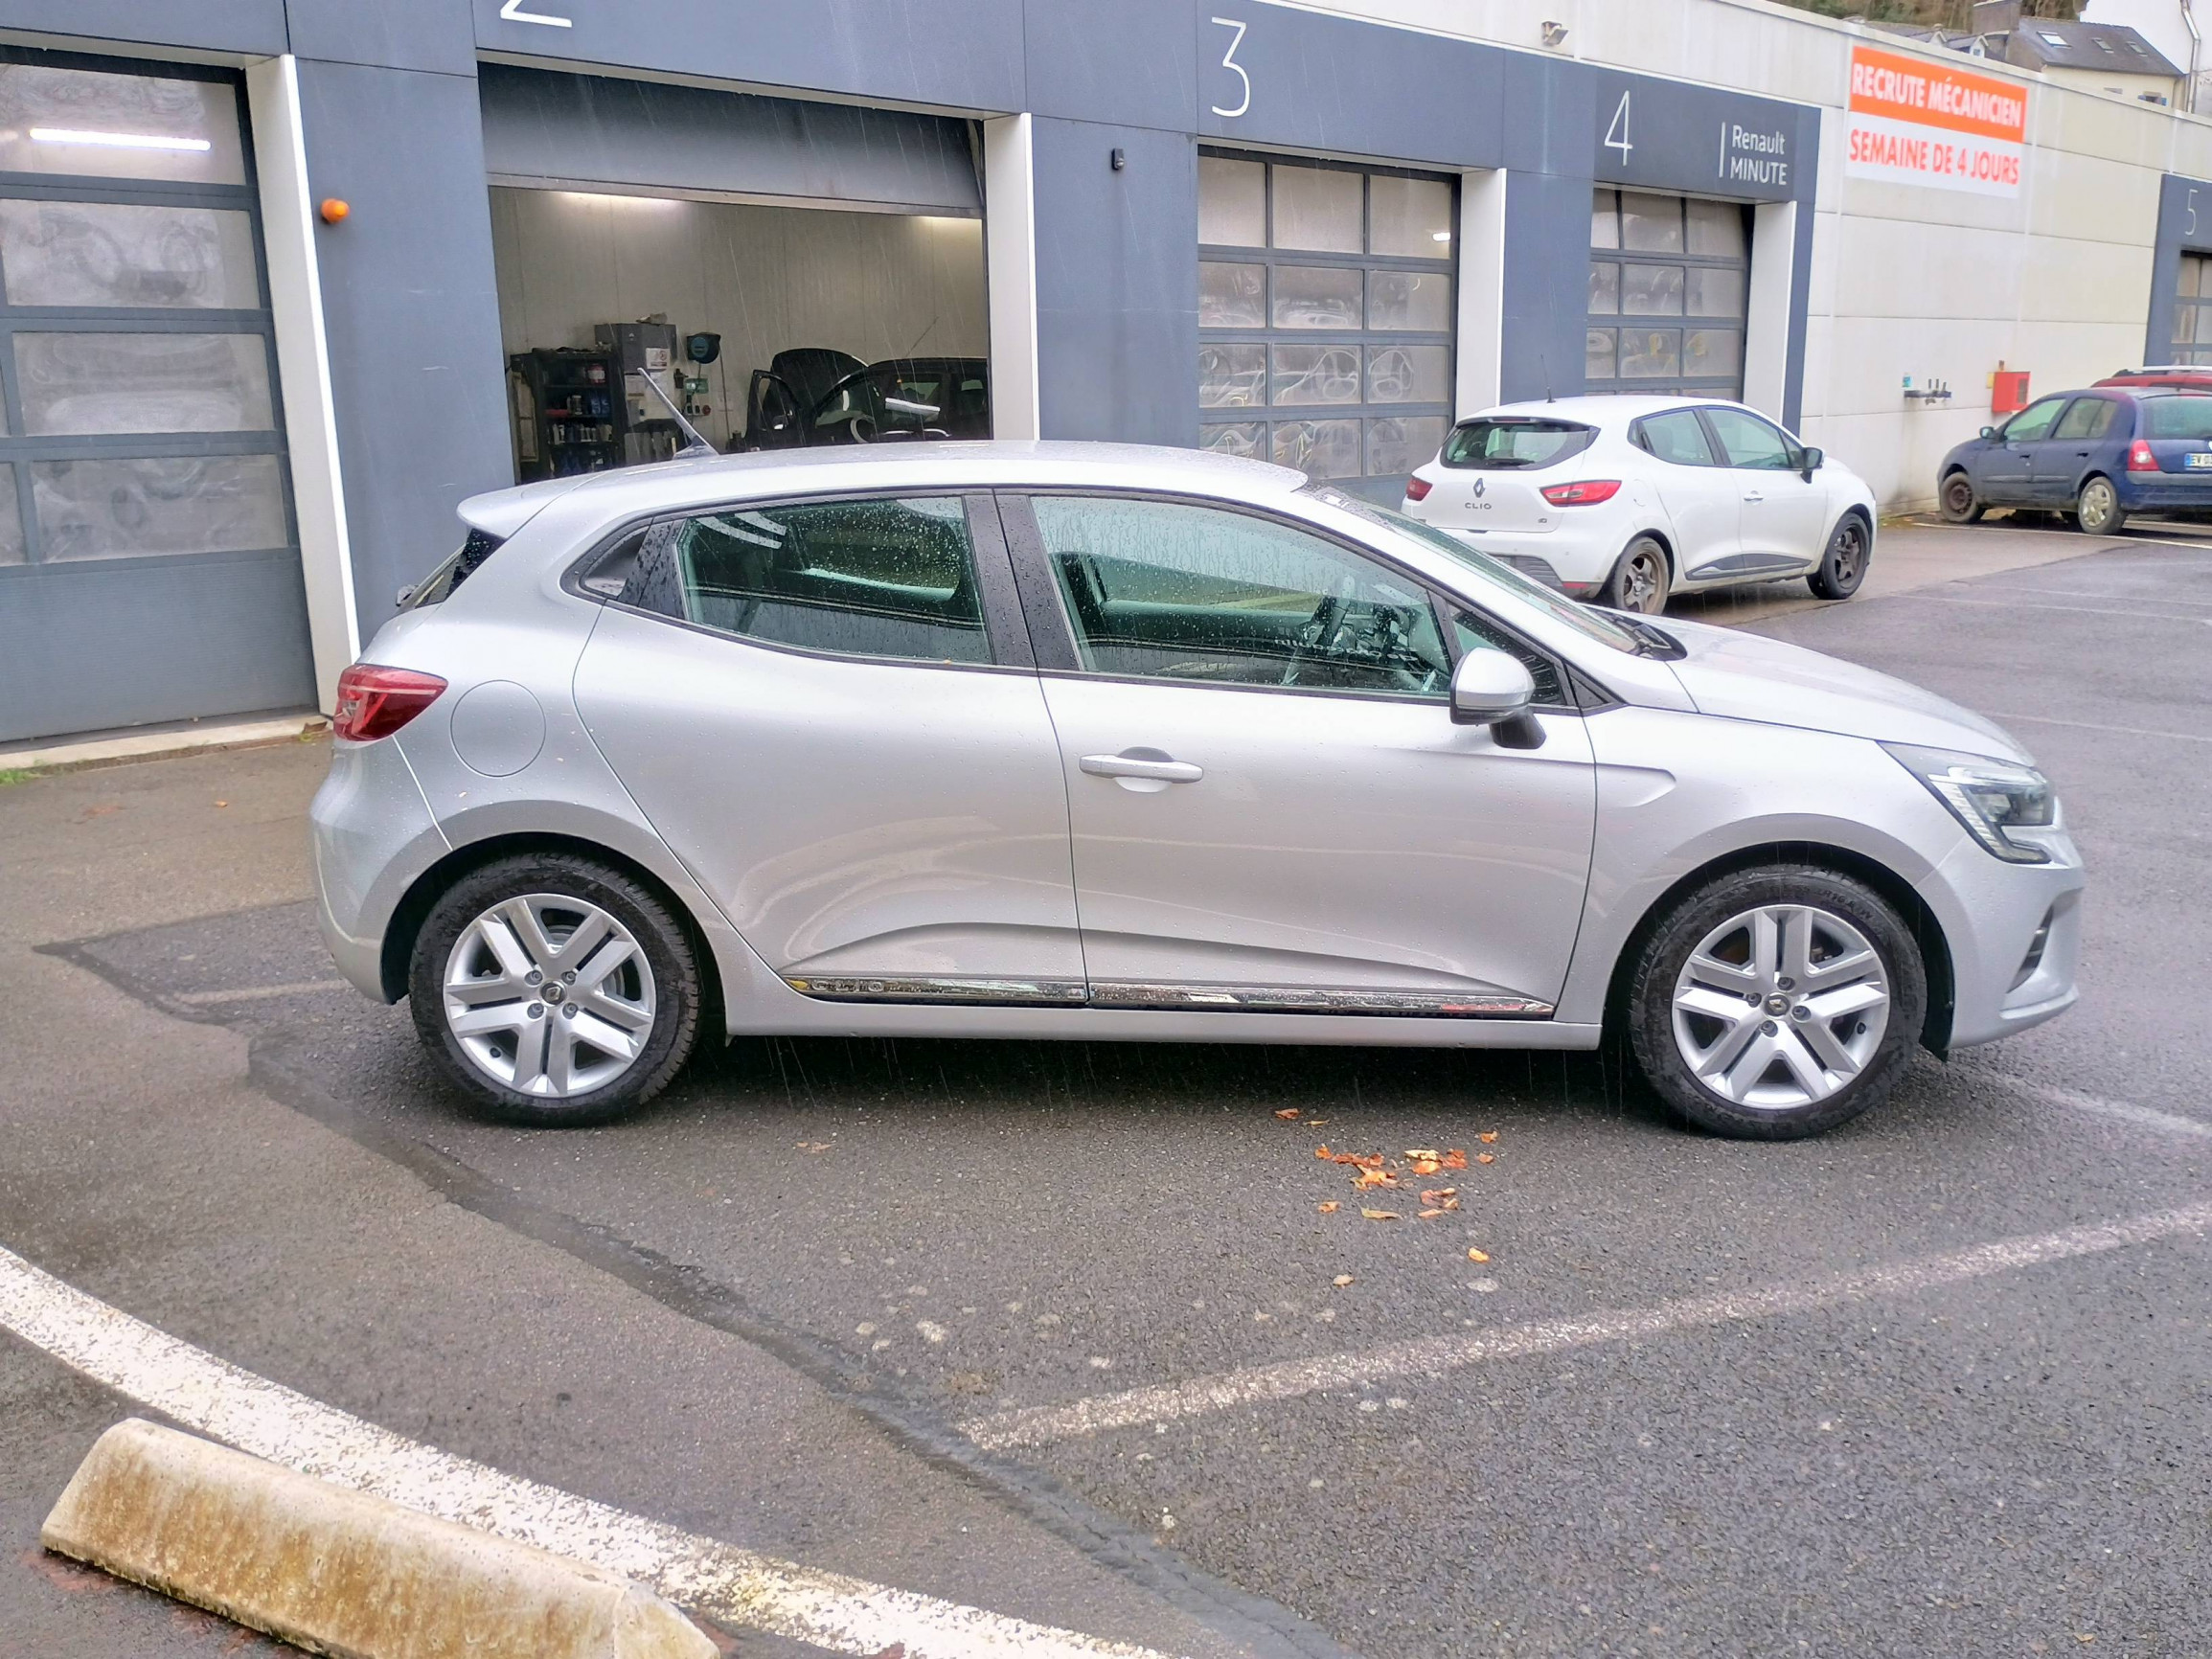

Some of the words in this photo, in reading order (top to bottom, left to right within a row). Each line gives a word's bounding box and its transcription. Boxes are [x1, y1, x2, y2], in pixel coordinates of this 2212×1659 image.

[1211, 16, 1250, 117] 3
[1852, 62, 1927, 108] RECRUTE
[1927, 76, 2022, 127] MÉCANICIEN
[1604, 90, 1633, 167] 4
[1731, 125, 1786, 155] Renault
[1850, 128, 1928, 170] SEMAINE
[1932, 143, 1953, 174] DE
[1956, 148, 1968, 176] 4
[1970, 150, 2019, 185] JOURS
[1730, 156, 1789, 186] MINUTE
[2184, 189, 2199, 236] 5
